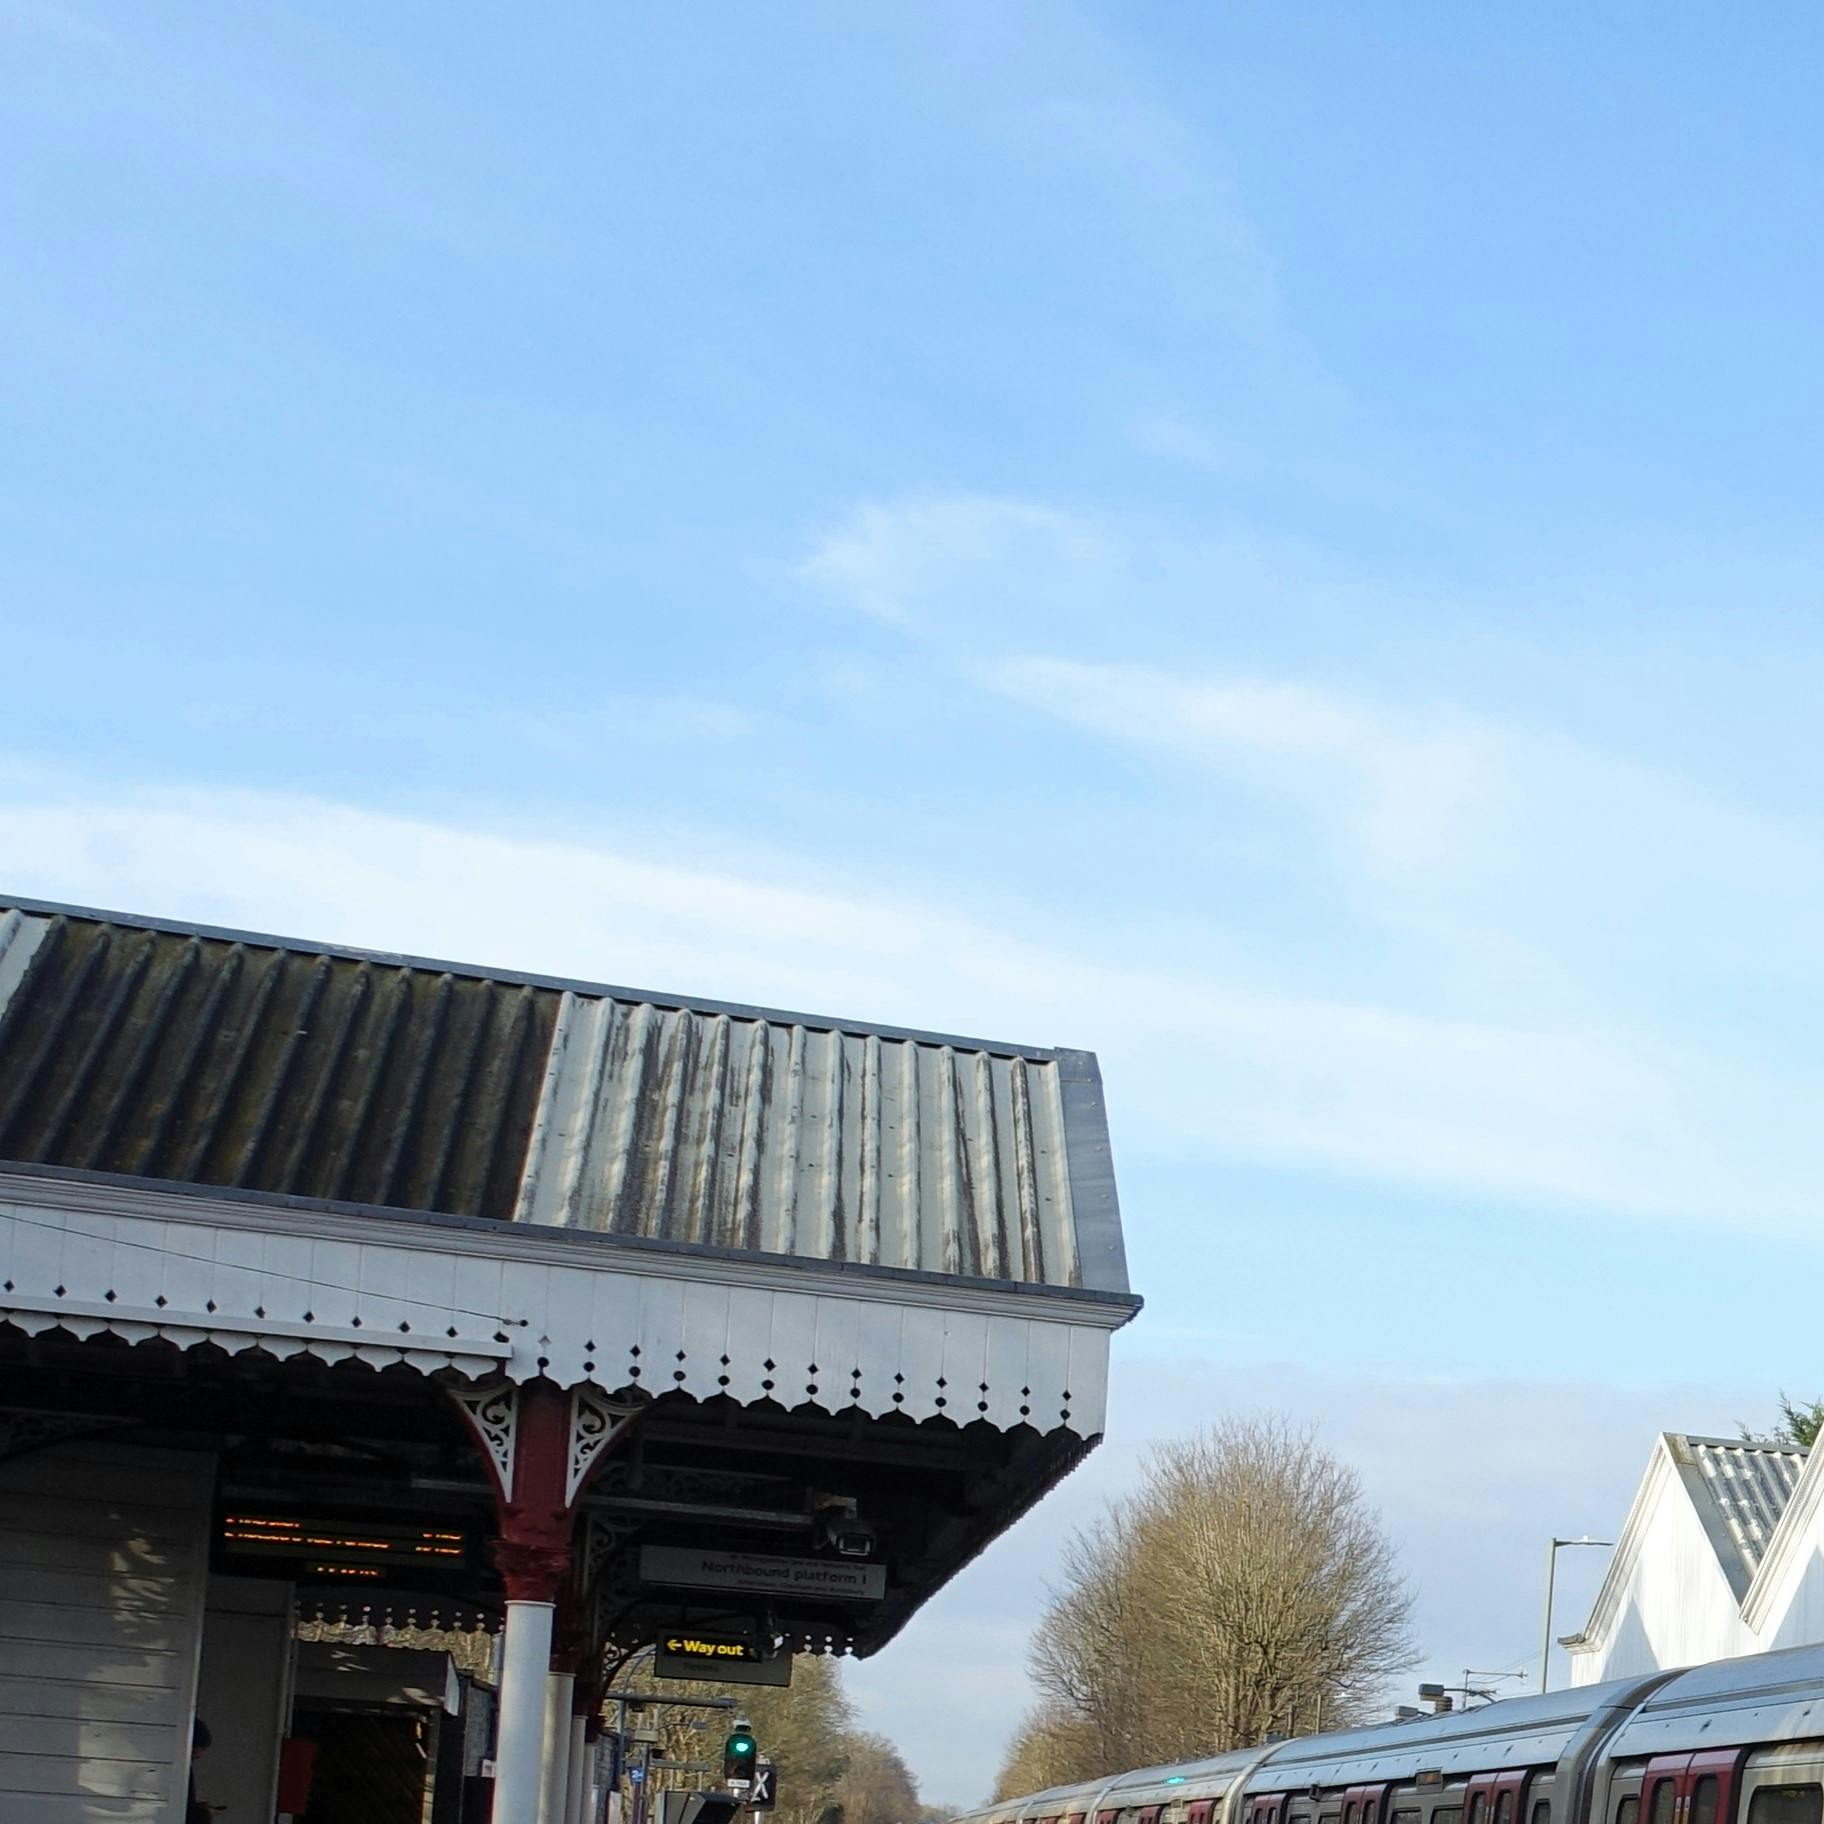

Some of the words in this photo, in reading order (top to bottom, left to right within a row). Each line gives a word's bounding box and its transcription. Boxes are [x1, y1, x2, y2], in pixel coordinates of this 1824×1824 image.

[702, 1560, 790, 1578] Northbound
[794, 1569, 857, 1585] platform
[683, 1640, 716, 1656] Way
[717, 1645, 744, 1656] out
